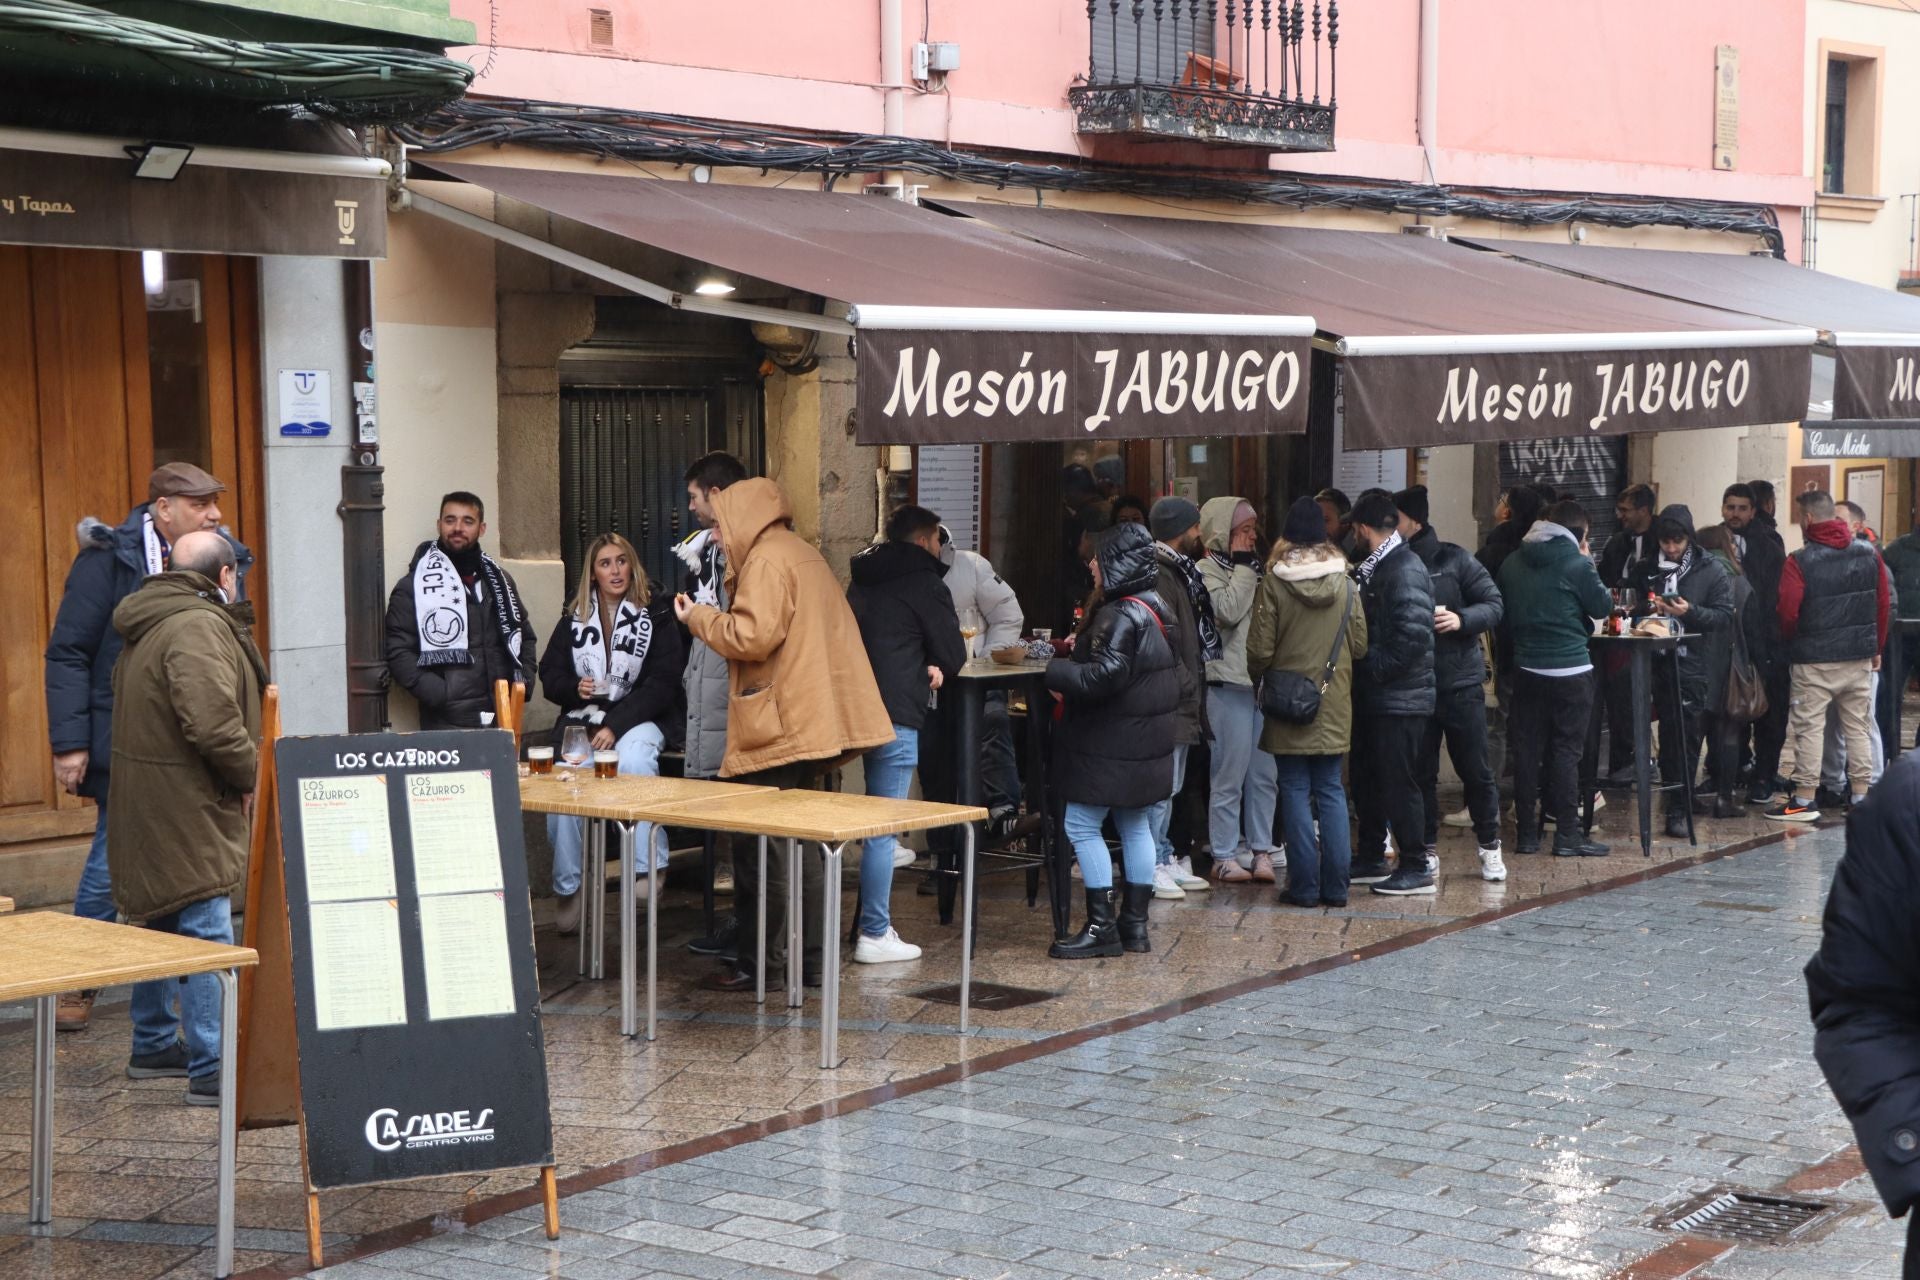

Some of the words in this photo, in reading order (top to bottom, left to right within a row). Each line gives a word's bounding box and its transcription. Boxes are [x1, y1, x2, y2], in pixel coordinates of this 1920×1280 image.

[1, 198, 15, 214] y
[19, 195, 76, 216] Tapas
[882, 346, 1067, 418] Mesón
[1084, 349, 1300, 432] JABUGO
[1436, 367, 1573, 424] Mesón
[1589, 358, 1750, 430] JABUGO
[1809, 430, 1836, 456] Casa
[335, 752, 367, 768] LOS
[371, 748, 460, 767] CAZURROS
[303, 780, 324, 791] LOS
[410, 776, 431, 787] LOS
[411, 784, 465, 797] CAZURROS
[304, 789, 360, 801] CAZURROS
[365, 1107, 494, 1152] CASARES
[406, 1137, 460, 1148] CENTRO
[463, 1134, 494, 1143] VINO
